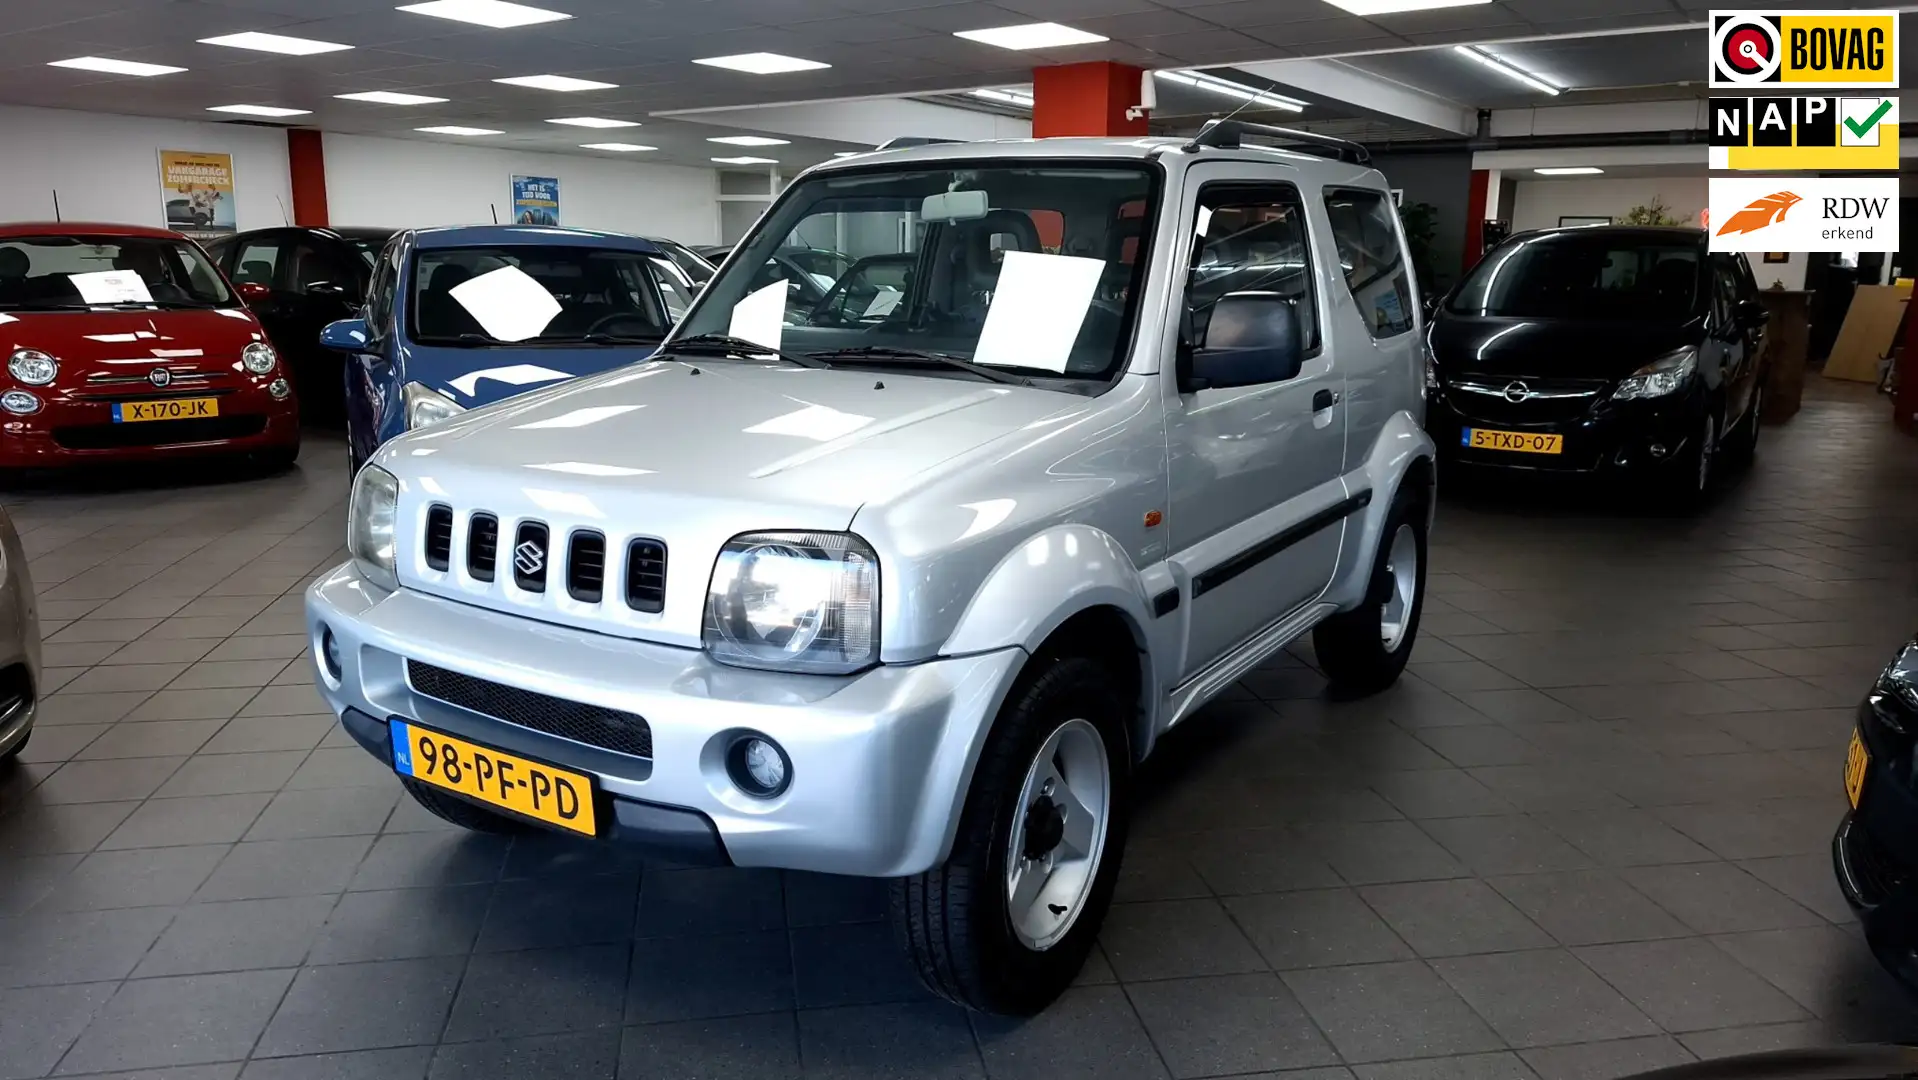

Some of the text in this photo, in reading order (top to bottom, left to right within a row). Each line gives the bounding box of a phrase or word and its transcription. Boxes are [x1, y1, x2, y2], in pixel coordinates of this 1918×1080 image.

[539, 184, 545, 192] IS
[132, 401, 208, 419] X-170-JK
[1475, 431, 1556, 451] 5-TXD-07
[397, 736, 579, 820] NL 98-PF-PD
